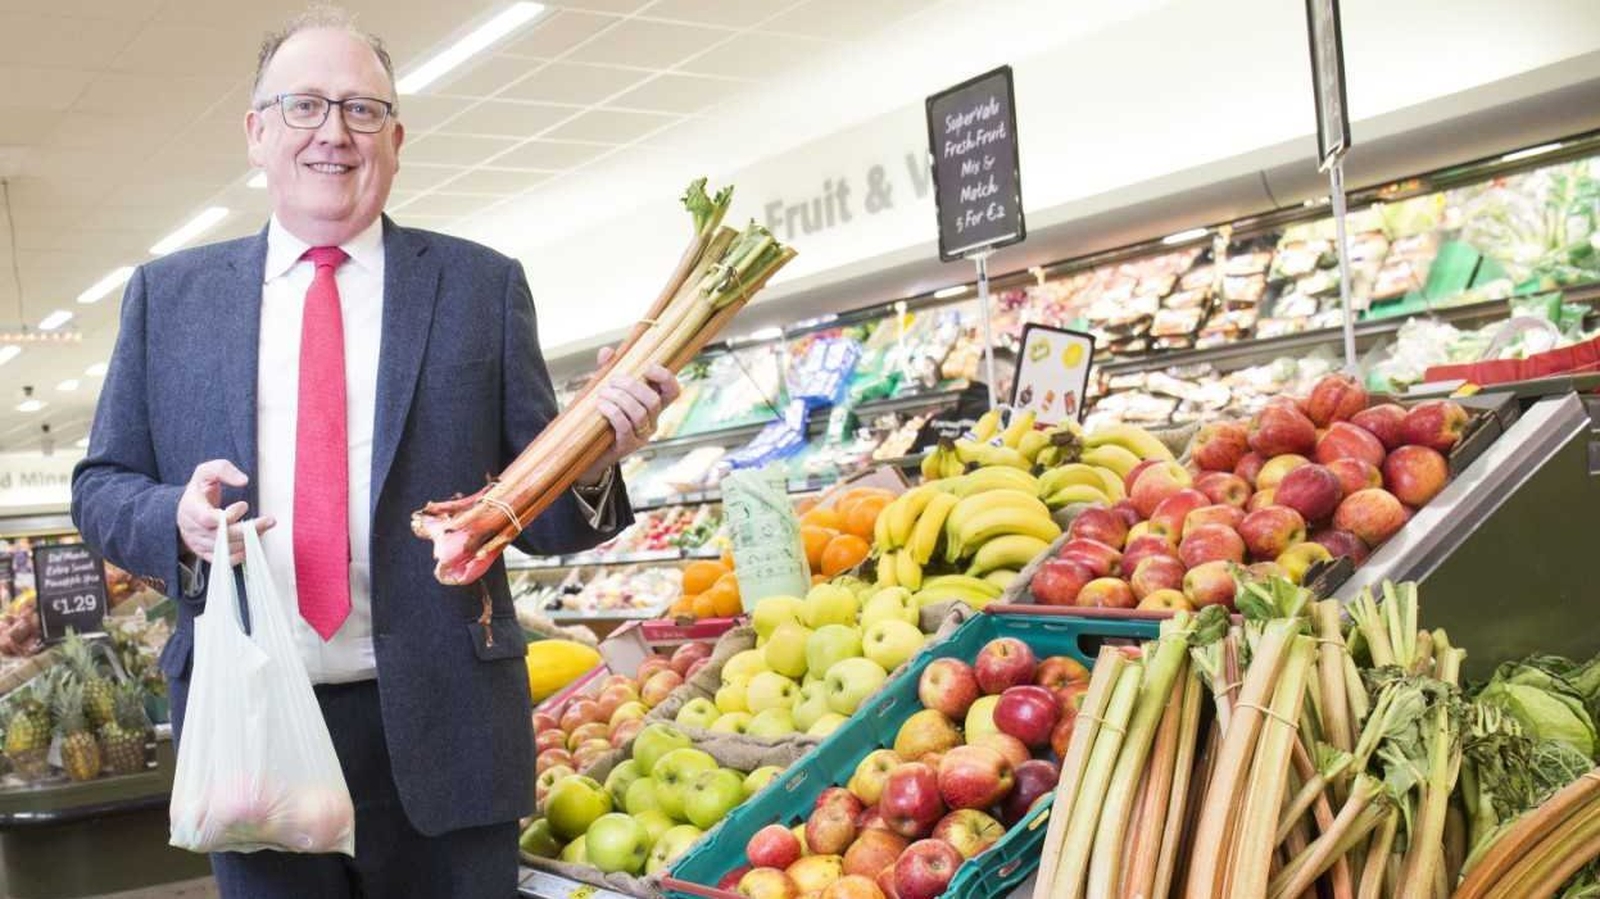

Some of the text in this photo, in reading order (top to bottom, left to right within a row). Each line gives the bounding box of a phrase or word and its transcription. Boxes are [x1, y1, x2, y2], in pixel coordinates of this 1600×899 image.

[945, 96, 1000, 137] SuperValu
[944, 120, 1007, 159] Fresh Fruit
[960, 158, 981, 178] Mix
[764, 178, 852, 240] Fruit
[864, 164, 894, 215] &
[959, 174, 999, 203] Match
[964, 209, 985, 228] For
[52, 594, 97, 615] €1.29
